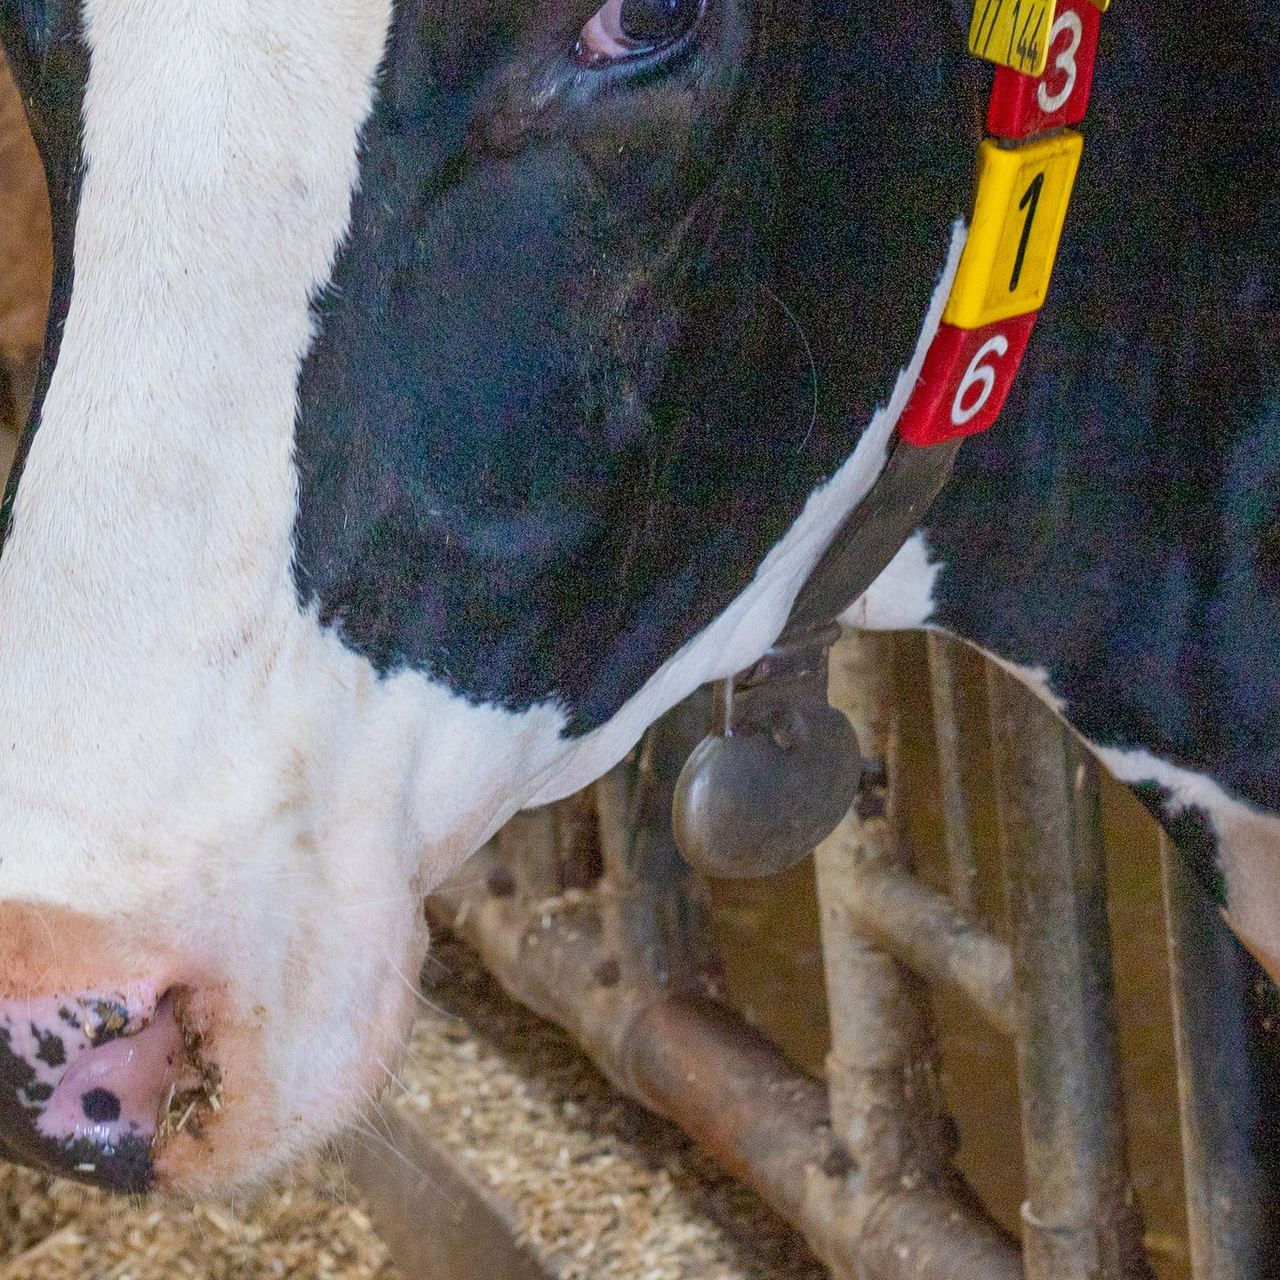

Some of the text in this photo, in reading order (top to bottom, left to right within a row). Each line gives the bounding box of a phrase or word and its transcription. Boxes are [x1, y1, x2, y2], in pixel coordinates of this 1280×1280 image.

[1007, 0, 1045, 72] 144
[950, 9, 1082, 426] 3 1 6
